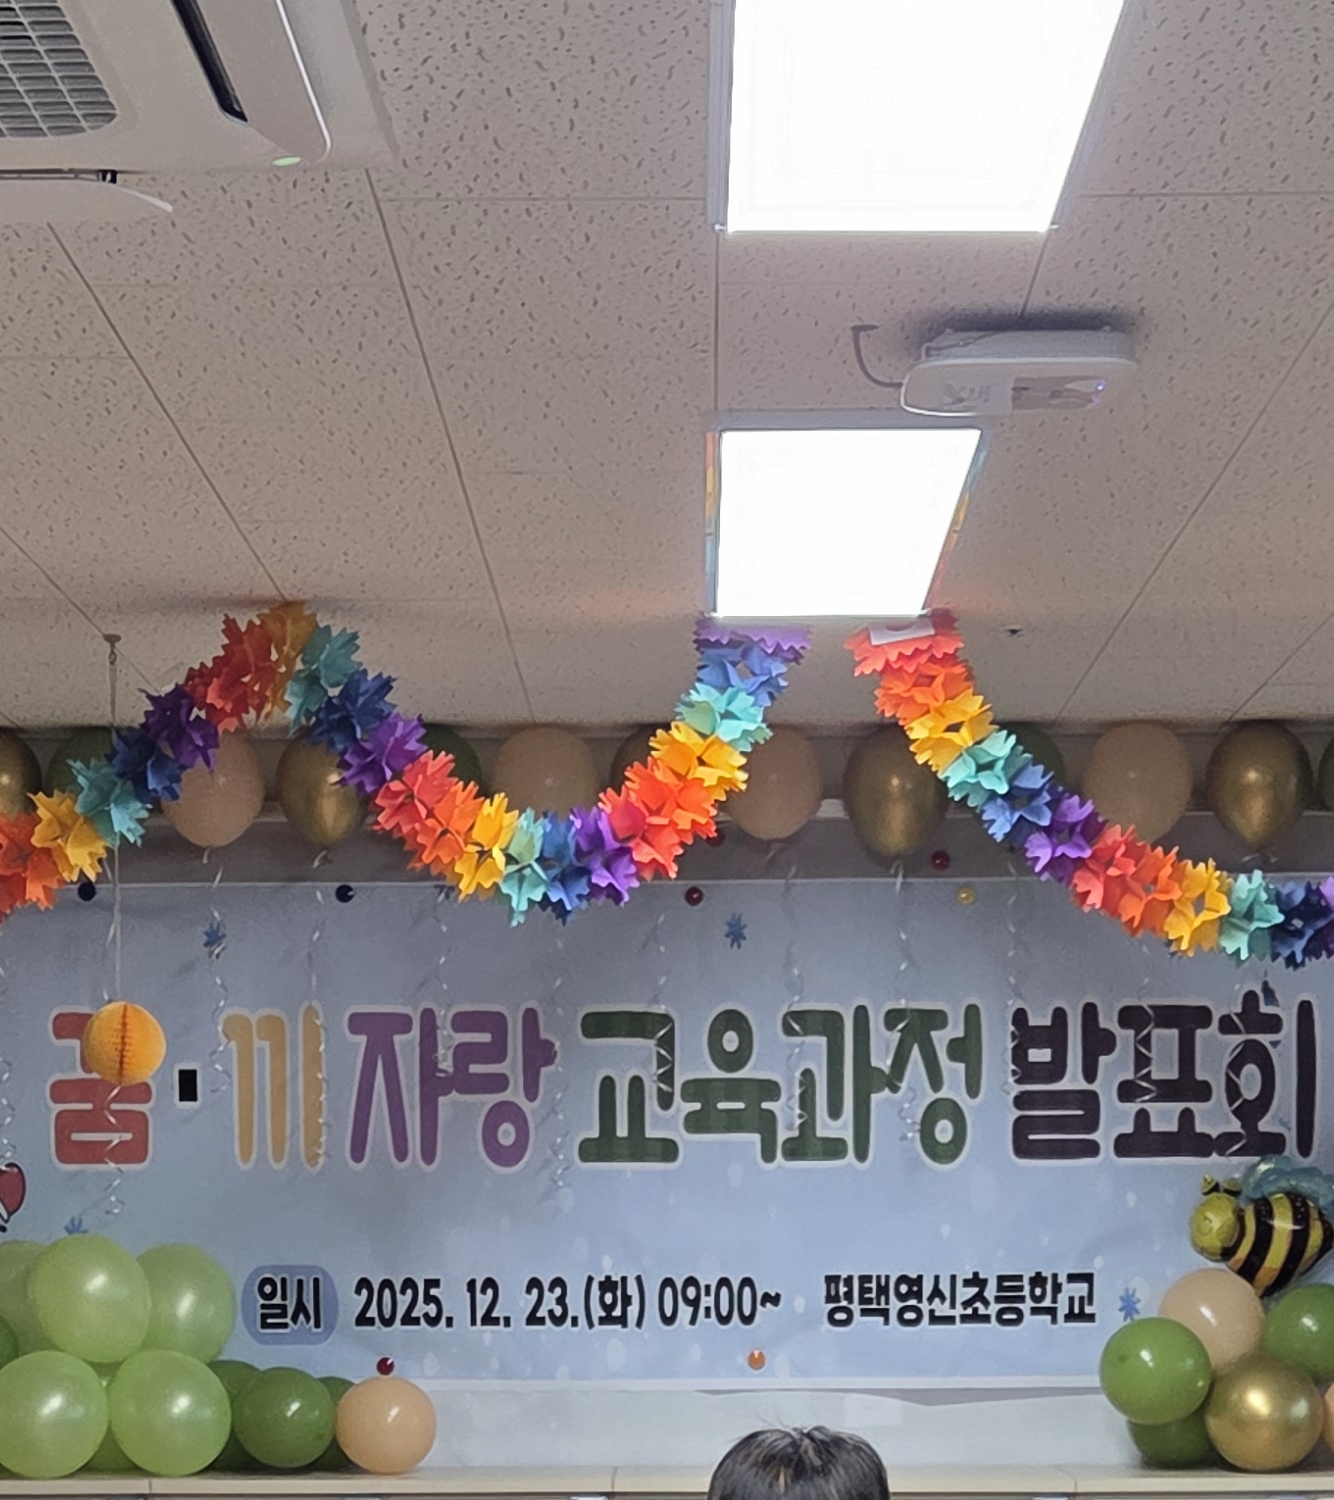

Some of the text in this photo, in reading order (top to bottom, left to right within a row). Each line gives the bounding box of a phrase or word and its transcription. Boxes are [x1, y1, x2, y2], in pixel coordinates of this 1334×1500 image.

[347, 1007, 557, 1167] 자랑
[578, 1003, 983, 1165] 교육과정
[1011, 990, 1316, 1160] 발표회
[257, 1271, 1098, 1332] 일시 2025. 12. 23.(화) 09:00~ 평택영신초등학교
